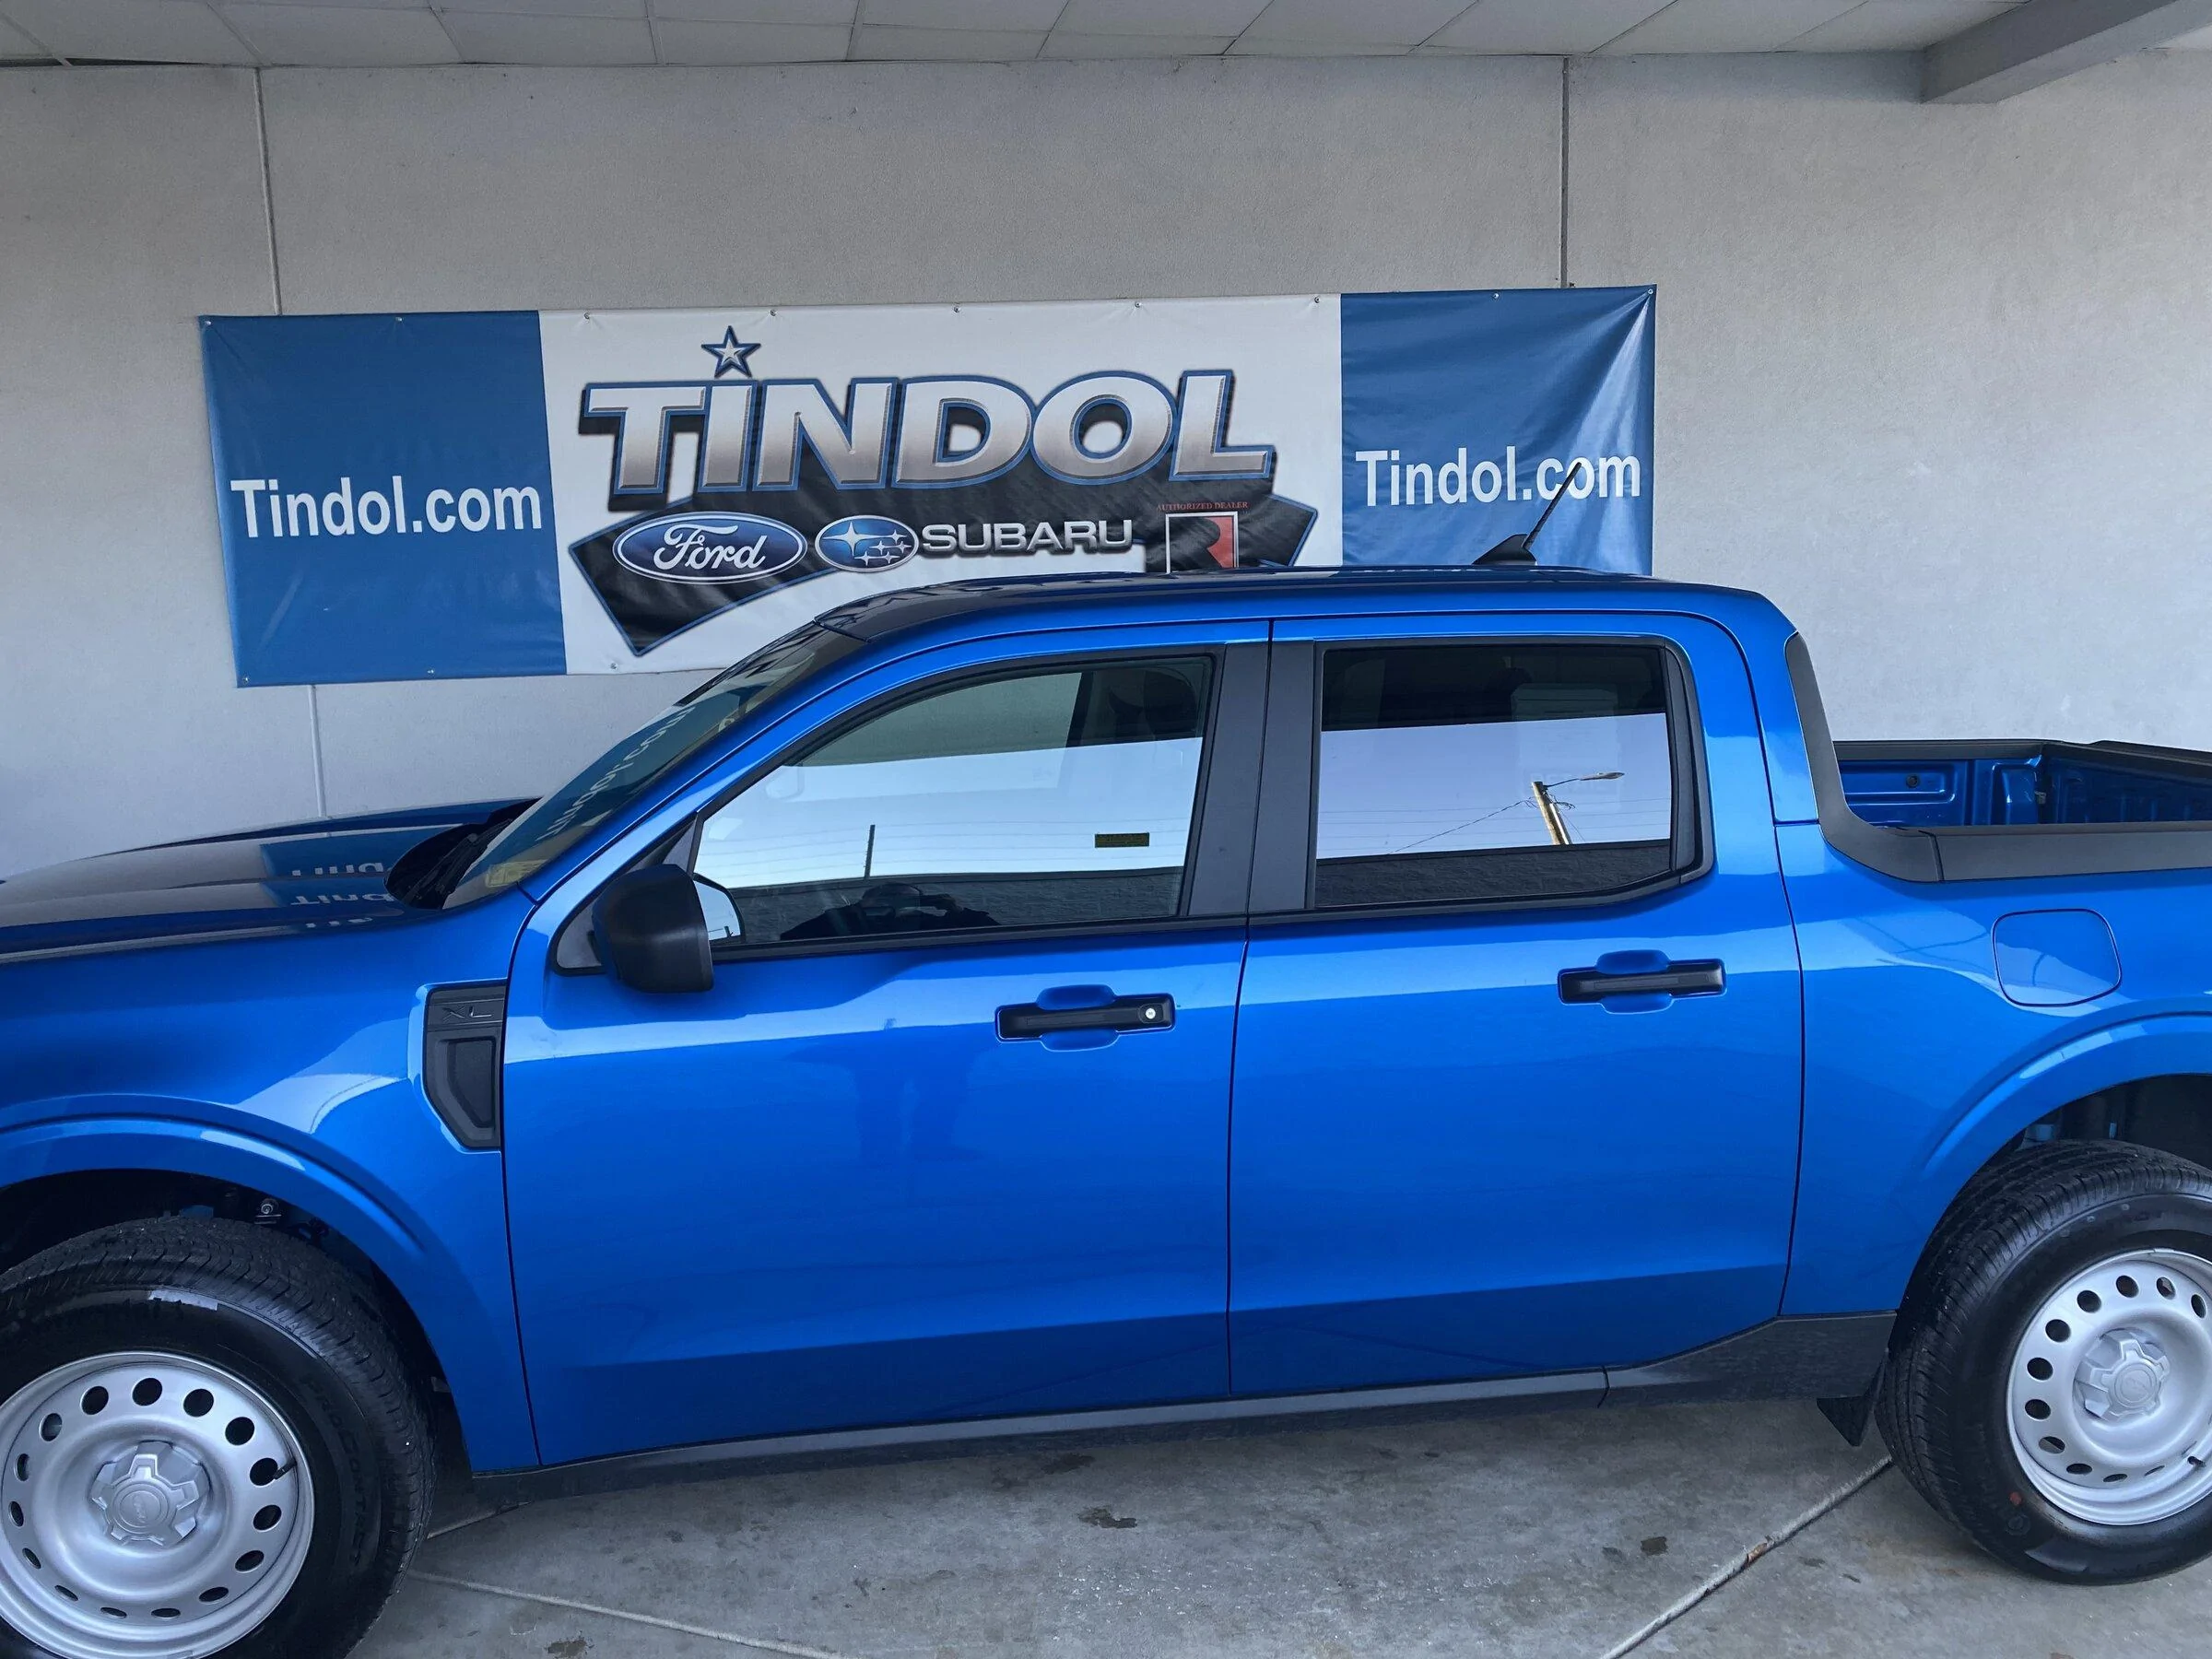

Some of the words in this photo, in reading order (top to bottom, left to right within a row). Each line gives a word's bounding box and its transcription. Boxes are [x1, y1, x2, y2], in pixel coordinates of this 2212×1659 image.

[582, 369, 1277, 495] TINDOL
[1355, 445, 1641, 506] Tindol.com
[230, 475, 542, 537] Tindol.com
[1158, 502, 1213, 512] AUTHORIZED
[1215, 500, 1250, 510] DEALER
[653, 523, 768, 571] Ford
[922, 519, 1133, 554] SUBARU
[442, 1004, 493, 1023] XL
